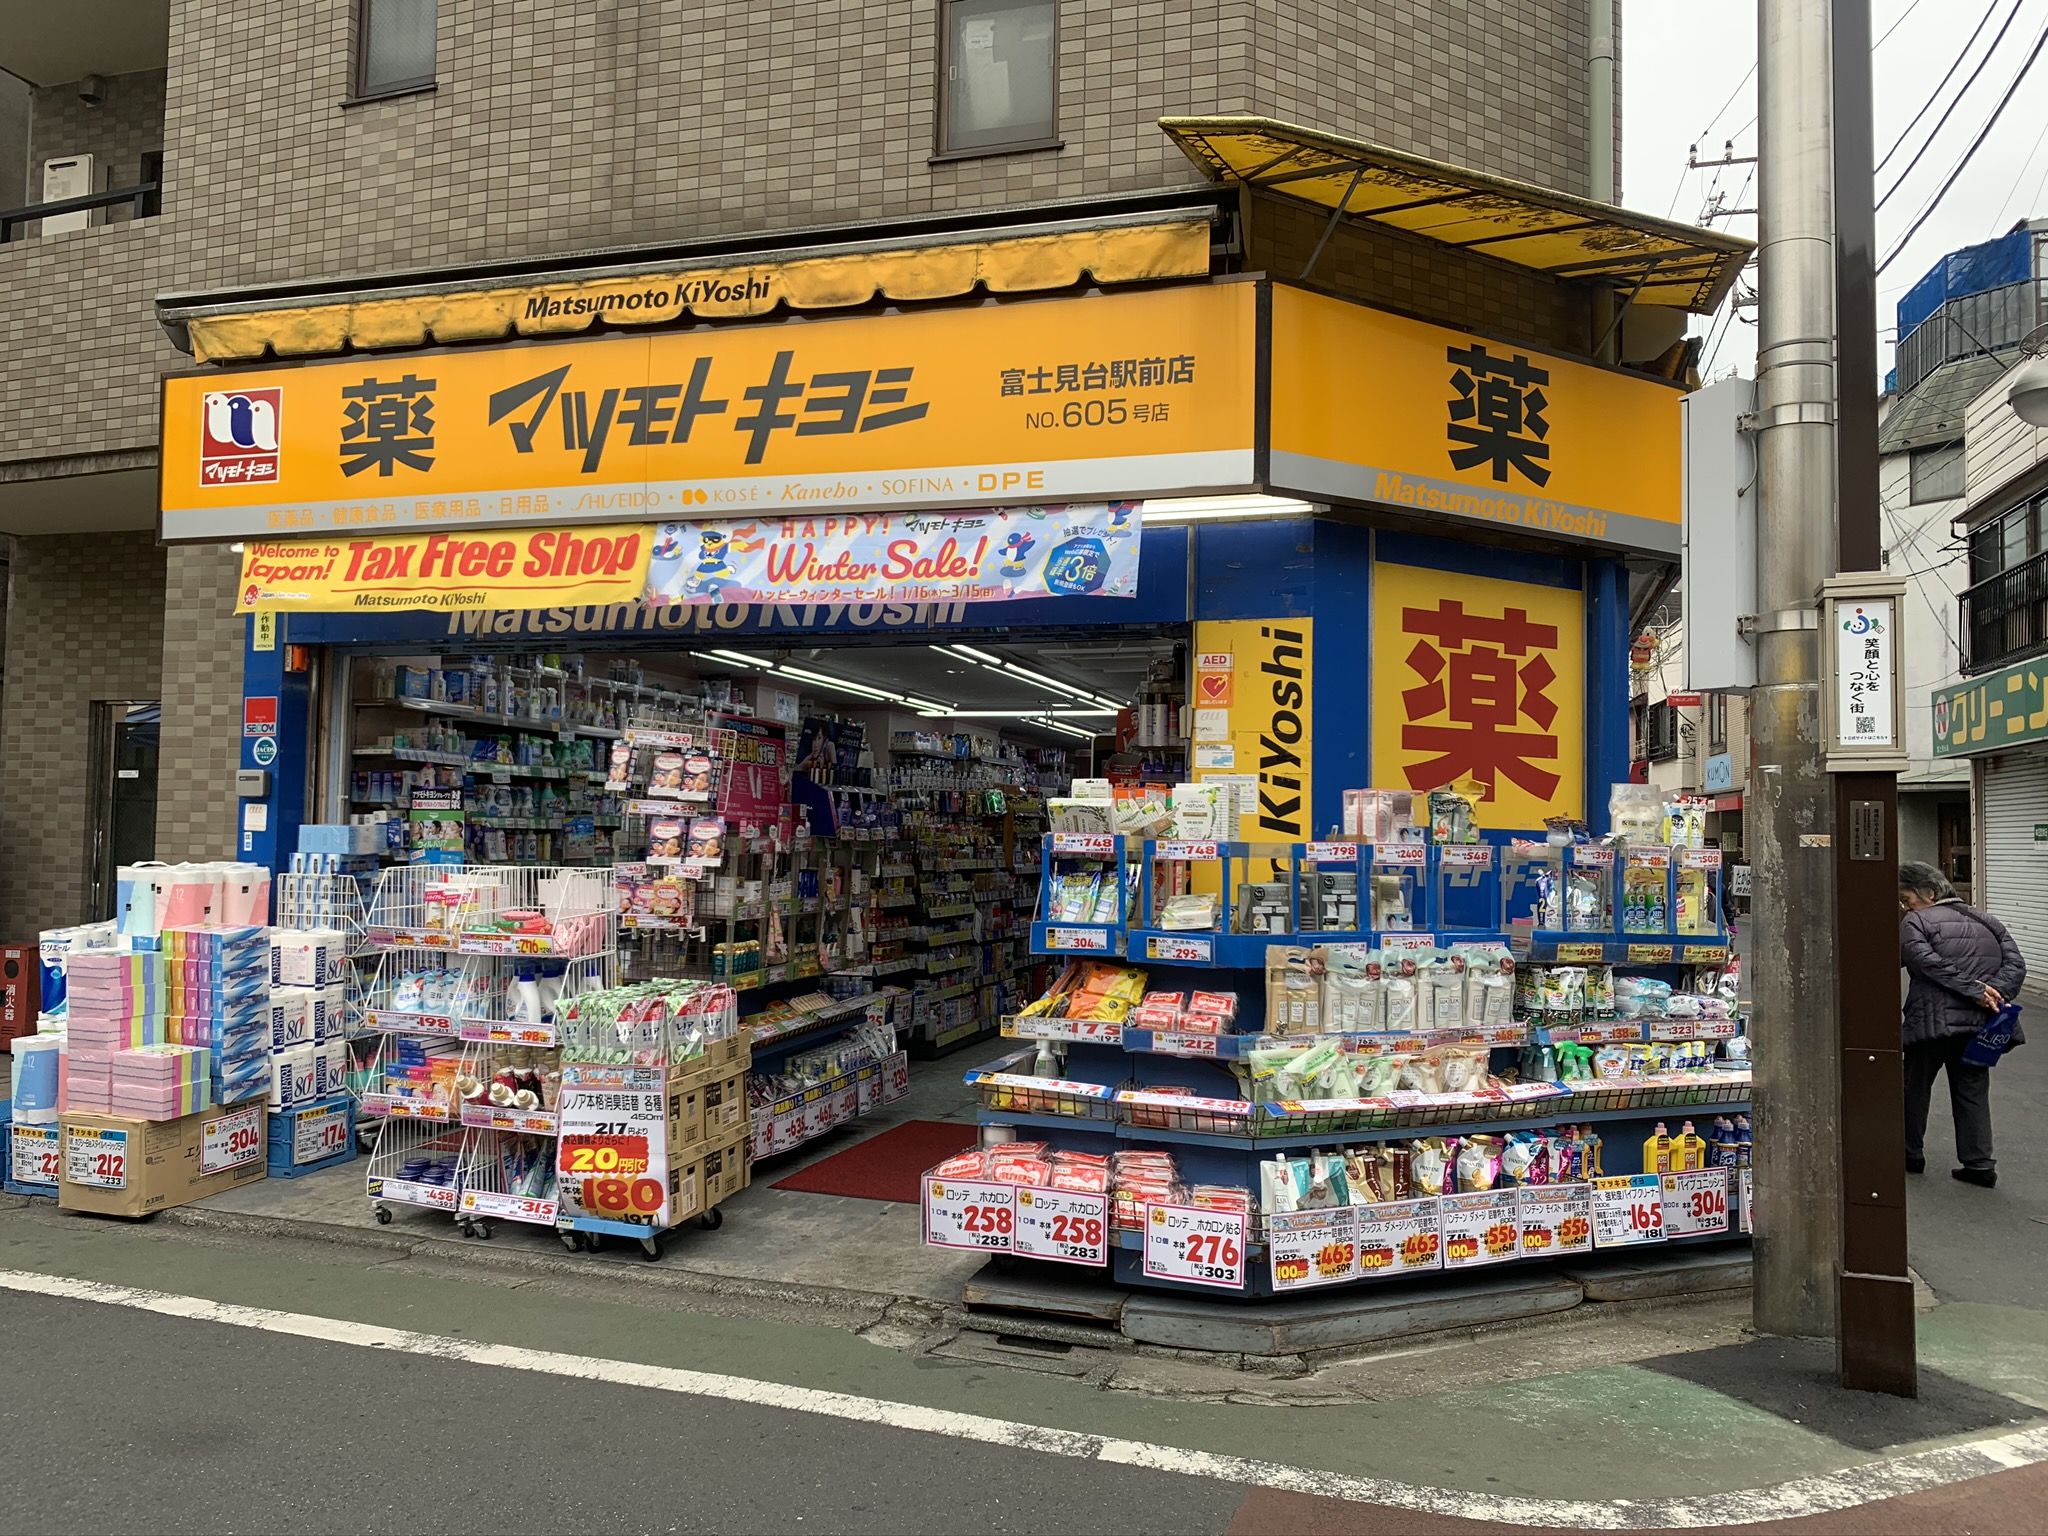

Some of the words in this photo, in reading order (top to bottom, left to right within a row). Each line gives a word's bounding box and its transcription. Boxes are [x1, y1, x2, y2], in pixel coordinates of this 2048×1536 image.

[524, 289, 669, 319] Matsumoto
[674, 275, 771, 305] KiYoshi
[1000, 355, 1195, 397] 富士見台駅前店
[489, 351, 930, 474] マツモトキヨシ
[1447, 343, 1551, 488] 薬
[340, 374, 437, 477] 薬
[205, 461, 276, 482] マツモトキヨシ
[267, 508, 314, 528] 医薬品
[333, 504, 396, 524] 健康食品
[414, 499, 481, 519] 医療用品
[500, 495, 549, 515] 日用品
[570, 492, 661, 511] SHISEIDO
[713, 485, 759, 503] KOSÉ
[781, 482, 858, 502] Kanebo
[881, 477, 953, 496] SOFINA
[978, 471, 1045, 492] DPE
[1373, 472, 1520, 526] Matsumoto
[1523, 505, 1606, 537] KiYoshi
[781, 516, 891, 539] HAPPY!
[905, 517, 986, 534] マツモトキヨシ
[251, 543, 320, 558] Welcome
[324, 545, 340, 557] to
[344, 541, 418, 582] Tax
[419, 534, 516, 579] Free
[523, 532, 640, 578] Shop
[767, 542, 876, 583] Winter
[881, 535, 989, 580] Sale!
[244, 557, 334, 584] Japan!
[354, 593, 438, 606] Matsumoto
[440, 591, 488, 606] KiYoshi
[1203, 655, 1227, 665] AED
[1865, 638, 1880, 691] 笑顔と心を
[1850, 671, 1864, 714] つなぐ街
[1402, 599, 1561, 802] 薬
[246, 724, 274, 733] SECOM
[1259, 626, 1303, 836] KiYoshi
[667, 734, 690, 743] 450
[1707, 761, 1730, 783] KUMON
[1083, 839, 1113, 847] 748
[1186, 846, 1215, 855] 748
[1333, 847, 1356, 856] 798
[1400, 850, 1423, 858] 2400
[1467, 851, 1488, 860] 548
[1595, 852, 1613, 860] 398
[1703, 855, 1719, 863] 508
[424, 936, 439, 945] 480
[1073, 938, 1094, 949] 304
[41, 944, 71, 952] エリエール
[1175, 949, 1198, 959] 295
[1580, 948, 1601, 957] 498
[1650, 949, 1670, 958] 462
[1706, 950, 1725, 959] 554
[327, 960, 342, 980] 80
[5, 984, 16, 1021] 消火器
[327, 1013, 341, 1034] 80
[418, 1017, 450, 1029] 198
[676, 1021, 695, 1030] レノア
[704, 1018, 722, 1028] レノア
[286, 1018, 303, 1041] 80
[1071, 1023, 1121, 1036] 175
[1495, 1030, 1513, 1041] 648
[1612, 1028, 1629, 1039] 138
[1671, 1026, 1691, 1034] 323
[1715, 1025, 1735, 1034] 323
[521, 1031, 539, 1041] 198
[1184, 1040, 1215, 1051] 212
[1394, 1041, 1414, 1051] 648
[580, 1073, 603, 1084] Winter
[604, 1072, 625, 1084] Sale!
[294, 1076, 311, 1098] 80
[1051, 1081, 1101, 1091] 157
[563, 1094, 639, 1111] レノア本格消臭詰替
[644, 1094, 663, 1111] 各種
[1201, 1100, 1248, 1109] 230
[420, 1106, 435, 1117] 362
[630, 1113, 664, 1121] 450ml
[525, 1120, 542, 1130] 185
[76, 1129, 113, 1139] マツキヨイイヨ
[229, 1127, 259, 1153] 304
[324, 1123, 346, 1147] 174
[240, 1148, 257, 1159] 334
[41, 1153, 59, 1174] 22
[97, 1154, 124, 1177] 212
[105, 1177, 121, 1185] 233
[1601, 1177, 1645, 1188] マツキヨイイヨ
[1677, 1178, 1725, 1191] パイプユニッシュ
[429, 1189, 454, 1202] 458
[562, 1185, 582, 1195] 本体
[582, 1178, 664, 1211] 180
[522, 1201, 554, 1215] 315
[1522, 1205, 1543, 1214] パンテーン
[1691, 1190, 1725, 1217] 304
[931, 1208, 948, 1216] 10個
[1631, 1203, 1662, 1230] 165
[964, 1206, 1012, 1234] 258
[1704, 1217, 1723, 1227] 334
[1052, 1215, 1102, 1246] 258
[1360, 1224, 1382, 1234] ラックス
[1562, 1219, 1589, 1238] 556
[1645, 1229, 1662, 1238] 181
[981, 1236, 1009, 1246] 283
[1274, 1233, 1298, 1243] ラックス
[1488, 1225, 1517, 1245] 556
[1524, 1235, 1542, 1246] 100
[1186, 1234, 1239, 1266] 276
[1406, 1234, 1439, 1255] 463
[1069, 1246, 1098, 1259] 283
[1321, 1244, 1354, 1265] 463
[1420, 1253, 1435, 1262] 509
[1205, 1266, 1235, 1280] 303
[1336, 1264, 1350, 1272] 509
